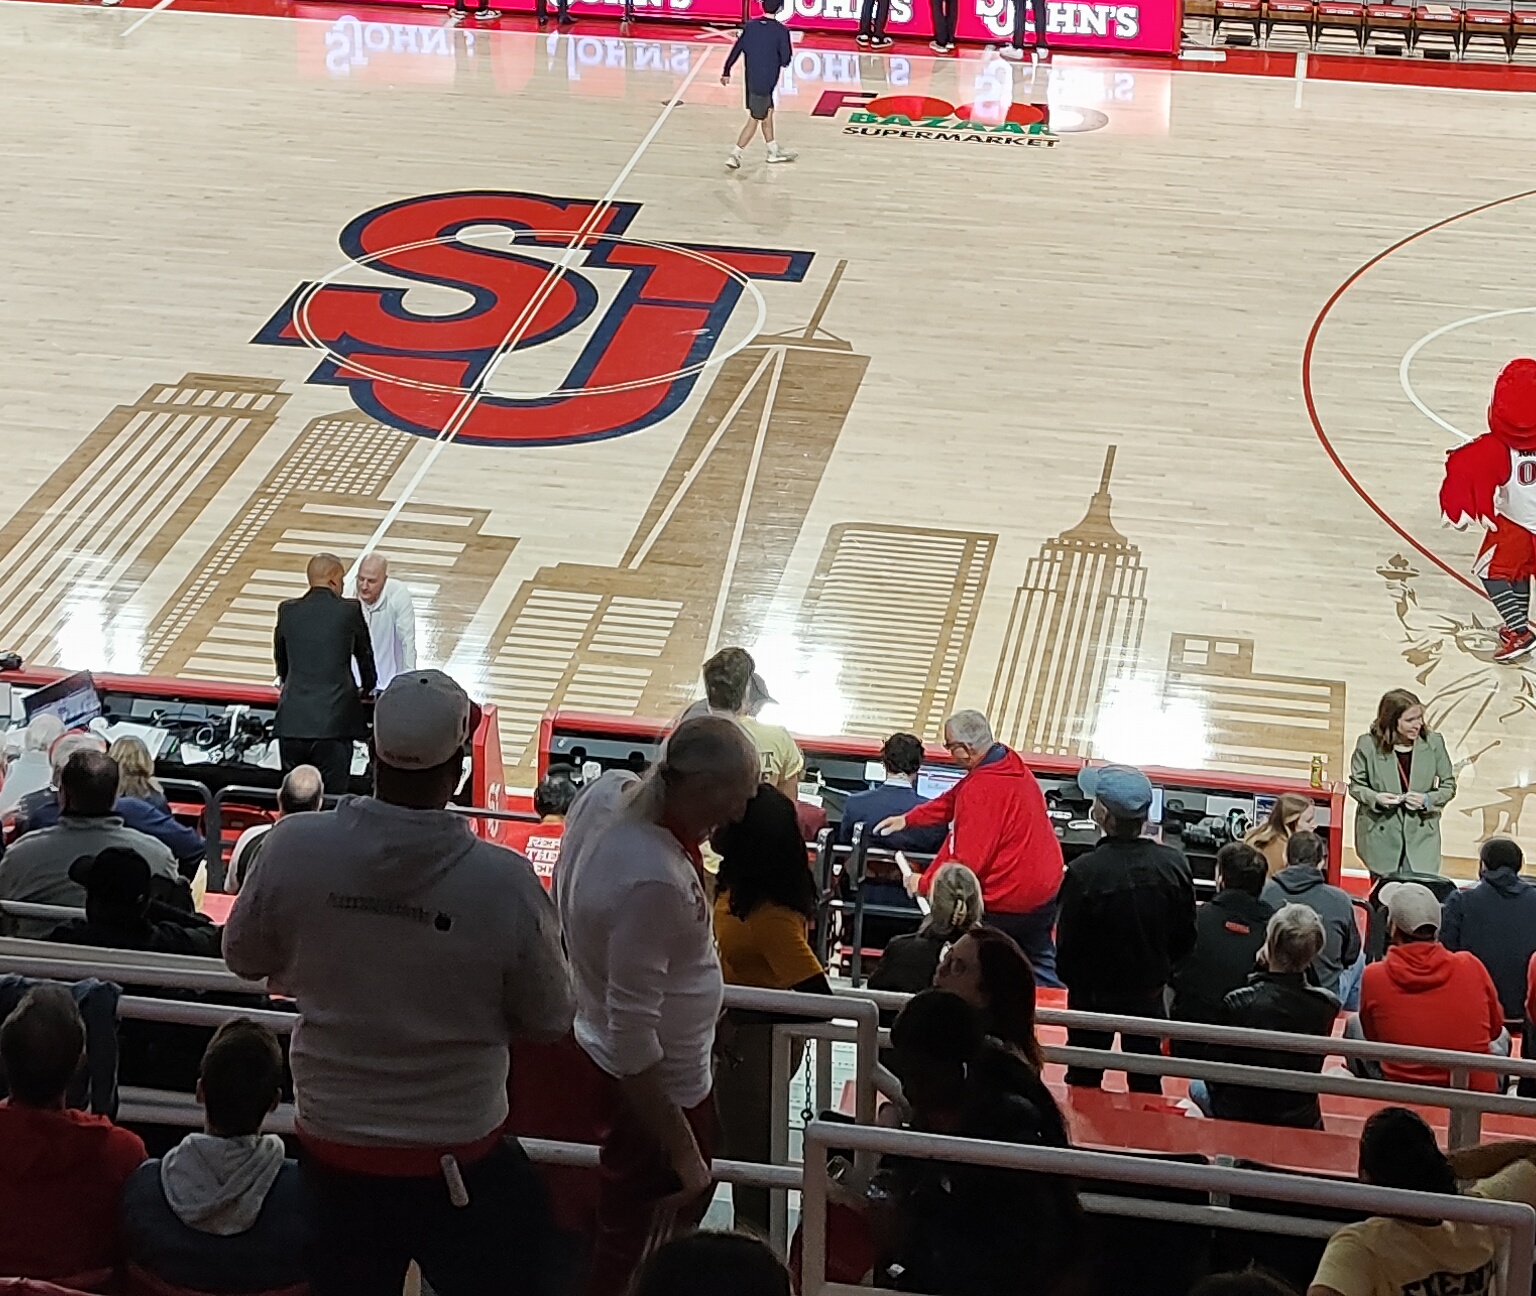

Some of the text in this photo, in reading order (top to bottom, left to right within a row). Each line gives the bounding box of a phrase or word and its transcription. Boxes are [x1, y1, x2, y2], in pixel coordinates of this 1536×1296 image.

[811, 90, 1109, 133] FOOD
[848, 111, 1057, 136] BAZAAR
[842, 125, 1061, 149] SUPERMARKET
